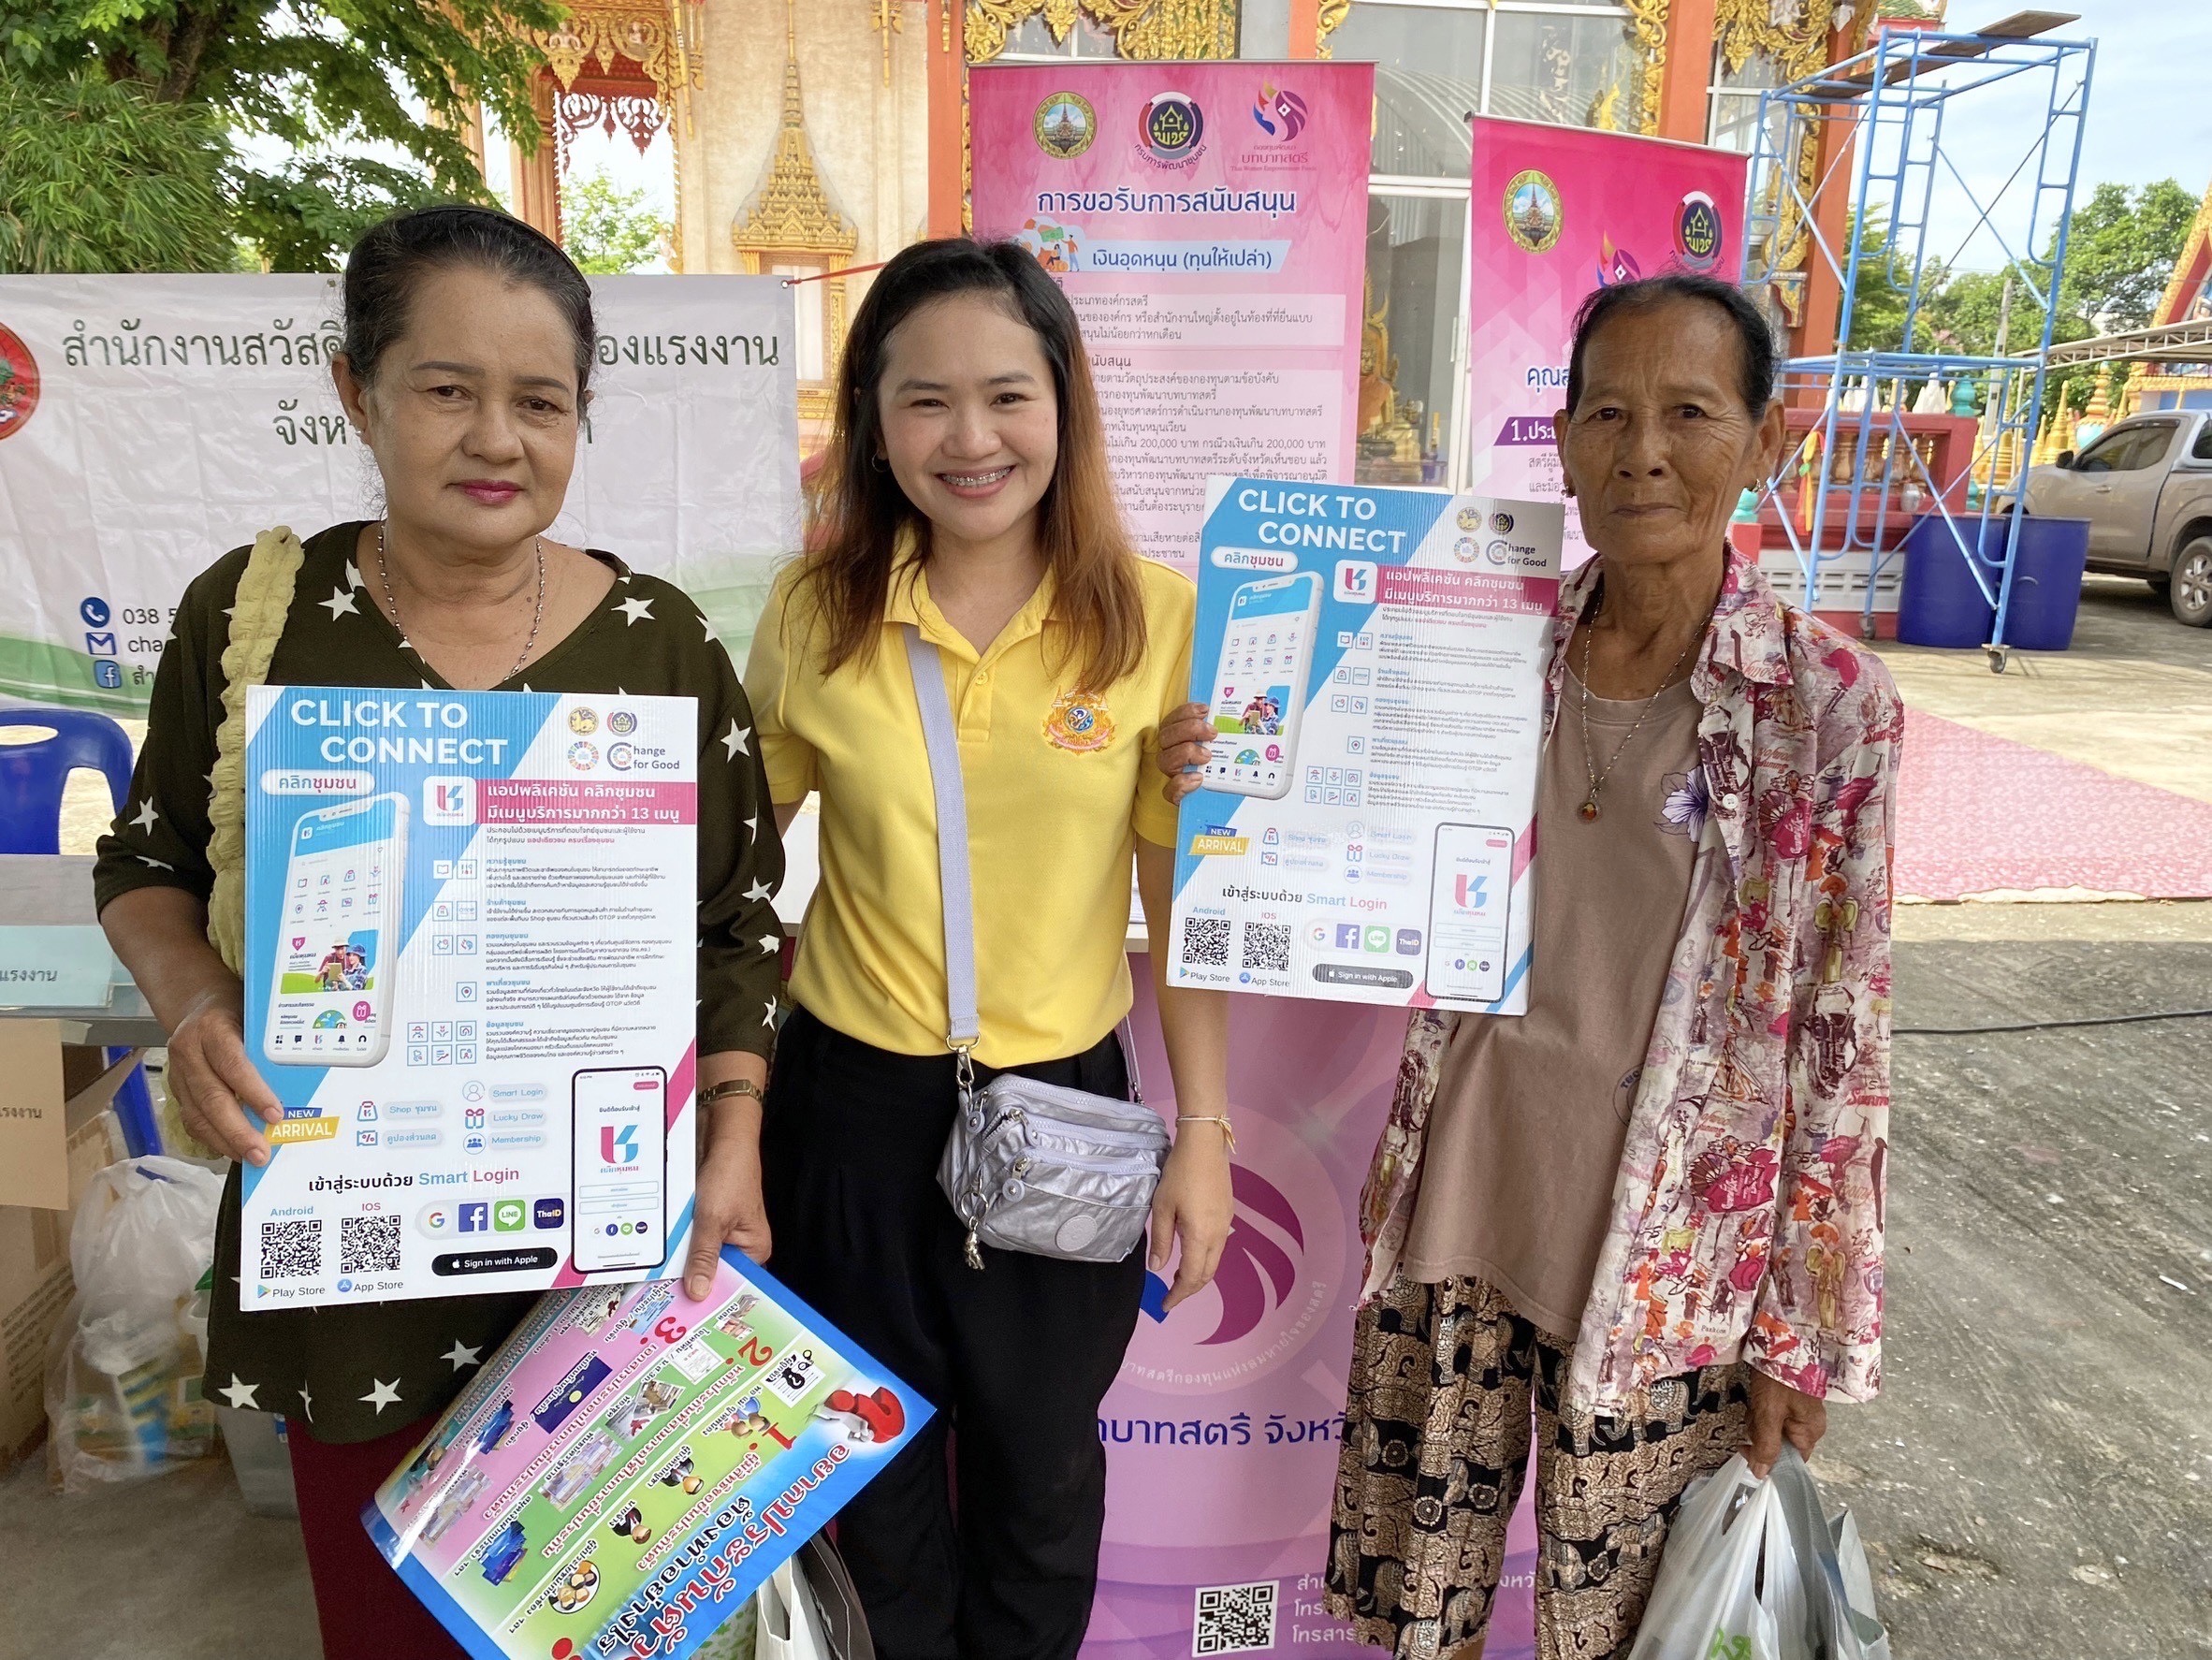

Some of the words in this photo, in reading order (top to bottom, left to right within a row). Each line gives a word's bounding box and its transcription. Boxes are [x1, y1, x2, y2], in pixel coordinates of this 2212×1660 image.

[1037, 186, 1296, 218] การขอรับการสนับสนุน
[1092, 248, 1178, 273] เงินอุดหนุน
[1183, 246, 1273, 271] (ทุนให้เปล่า)
[62, 318, 347, 366] สำนักงานสวัสดิ
[1140, 438, 1177, 449] 200,000
[1181, 439, 1199, 448] บาท
[1267, 439, 1303, 449] 200,000
[1307, 440, 1326, 448] บาท
[1238, 488, 1328, 517] CLICK
[1336, 496, 1376, 520] TO
[1258, 521, 1405, 555] CONNECT
[1224, 549, 1285, 569] คลิกชุมชน
[1506, 556, 1521, 565] for
[1522, 558, 1547, 568] Good
[1464, 575, 1524, 591] คลิกชุมชน
[1502, 598, 1518, 609] 13
[1521, 600, 1543, 616] เมนู
[123, 609, 160, 624] 038
[128, 636, 164, 652] cha
[291, 699, 409, 729] CLICK
[416, 700, 468, 728] TO
[320, 735, 508, 765] CONNECT
[633, 760, 648, 769] for
[651, 760, 680, 769] Good
[278, 773, 357, 794] คลิกชุมชน
[487, 781, 579, 798] แอปพลิเคชัน
[584, 782, 656, 801] คลิกชุมชน
[487, 805, 626, 823] มีเมนูบริการมากกว่า
[632, 808, 649, 820] 13
[655, 808, 679, 823] เมนู
[1210, 827, 1232, 837] NEW
[1197, 837, 1244, 854] ARRIVAL
[1366, 869, 1407, 881] Membership
[1222, 884, 1302, 905] เข้าสู่ระบบด้วย
[1306, 893, 1346, 908] Smart
[1349, 896, 1388, 912] Login
[1192, 906, 1226, 916] Android
[1190, 971, 1208, 982] Play
[1209, 973, 1230, 983] Store
[1251, 977, 1267, 987] App
[1269, 978, 1290, 987] Store
[1338, 969, 1354, 981] Sign
[1355, 971, 1362, 981] in
[1363, 972, 1376, 982] with
[1377, 973, 1398, 984] Apple
[492, 1086, 518, 1099] Smart
[521, 1085, 545, 1099] Login
[287, 1108, 315, 1120] NEW
[389, 1103, 412, 1115] Shop
[415, 1102, 438, 1114] ชุมชน
[492, 1113, 518, 1124] Lucky
[521, 1111, 544, 1121] Draw
[270, 1119, 333, 1139] ARRIVAL
[491, 1133, 542, 1145] Membership
[308, 1169, 414, 1196] เข้าสู่ระบบด้วย
[417, 1170, 469, 1187] Smart
[473, 1167, 520, 1187] Login
[269, 1205, 314, 1217] Android
[361, 1201, 382, 1212] IOS
[501, 1208, 519, 1219] LINE
[463, 1258, 482, 1269] Sign
[484, 1257, 493, 1267] in
[495, 1256, 512, 1267] with
[514, 1254, 539, 1267] Apple
[272, 1289, 295, 1299] Play
[298, 1286, 326, 1296] Store
[353, 1283, 374, 1293] App
[377, 1280, 403, 1290] Store
[638, 1312, 688, 1348] 3.
[724, 1333, 775, 1371] 2.
[748, 1419, 799, 1455] 1.
[634, 1449, 763, 1574] ผู้มีสิทธิขอยื่นประกันตัว
[626, 1439, 852, 1655] อยากประกันตัว
[593, 1491, 758, 1658] ต้องทำอย่างไร
